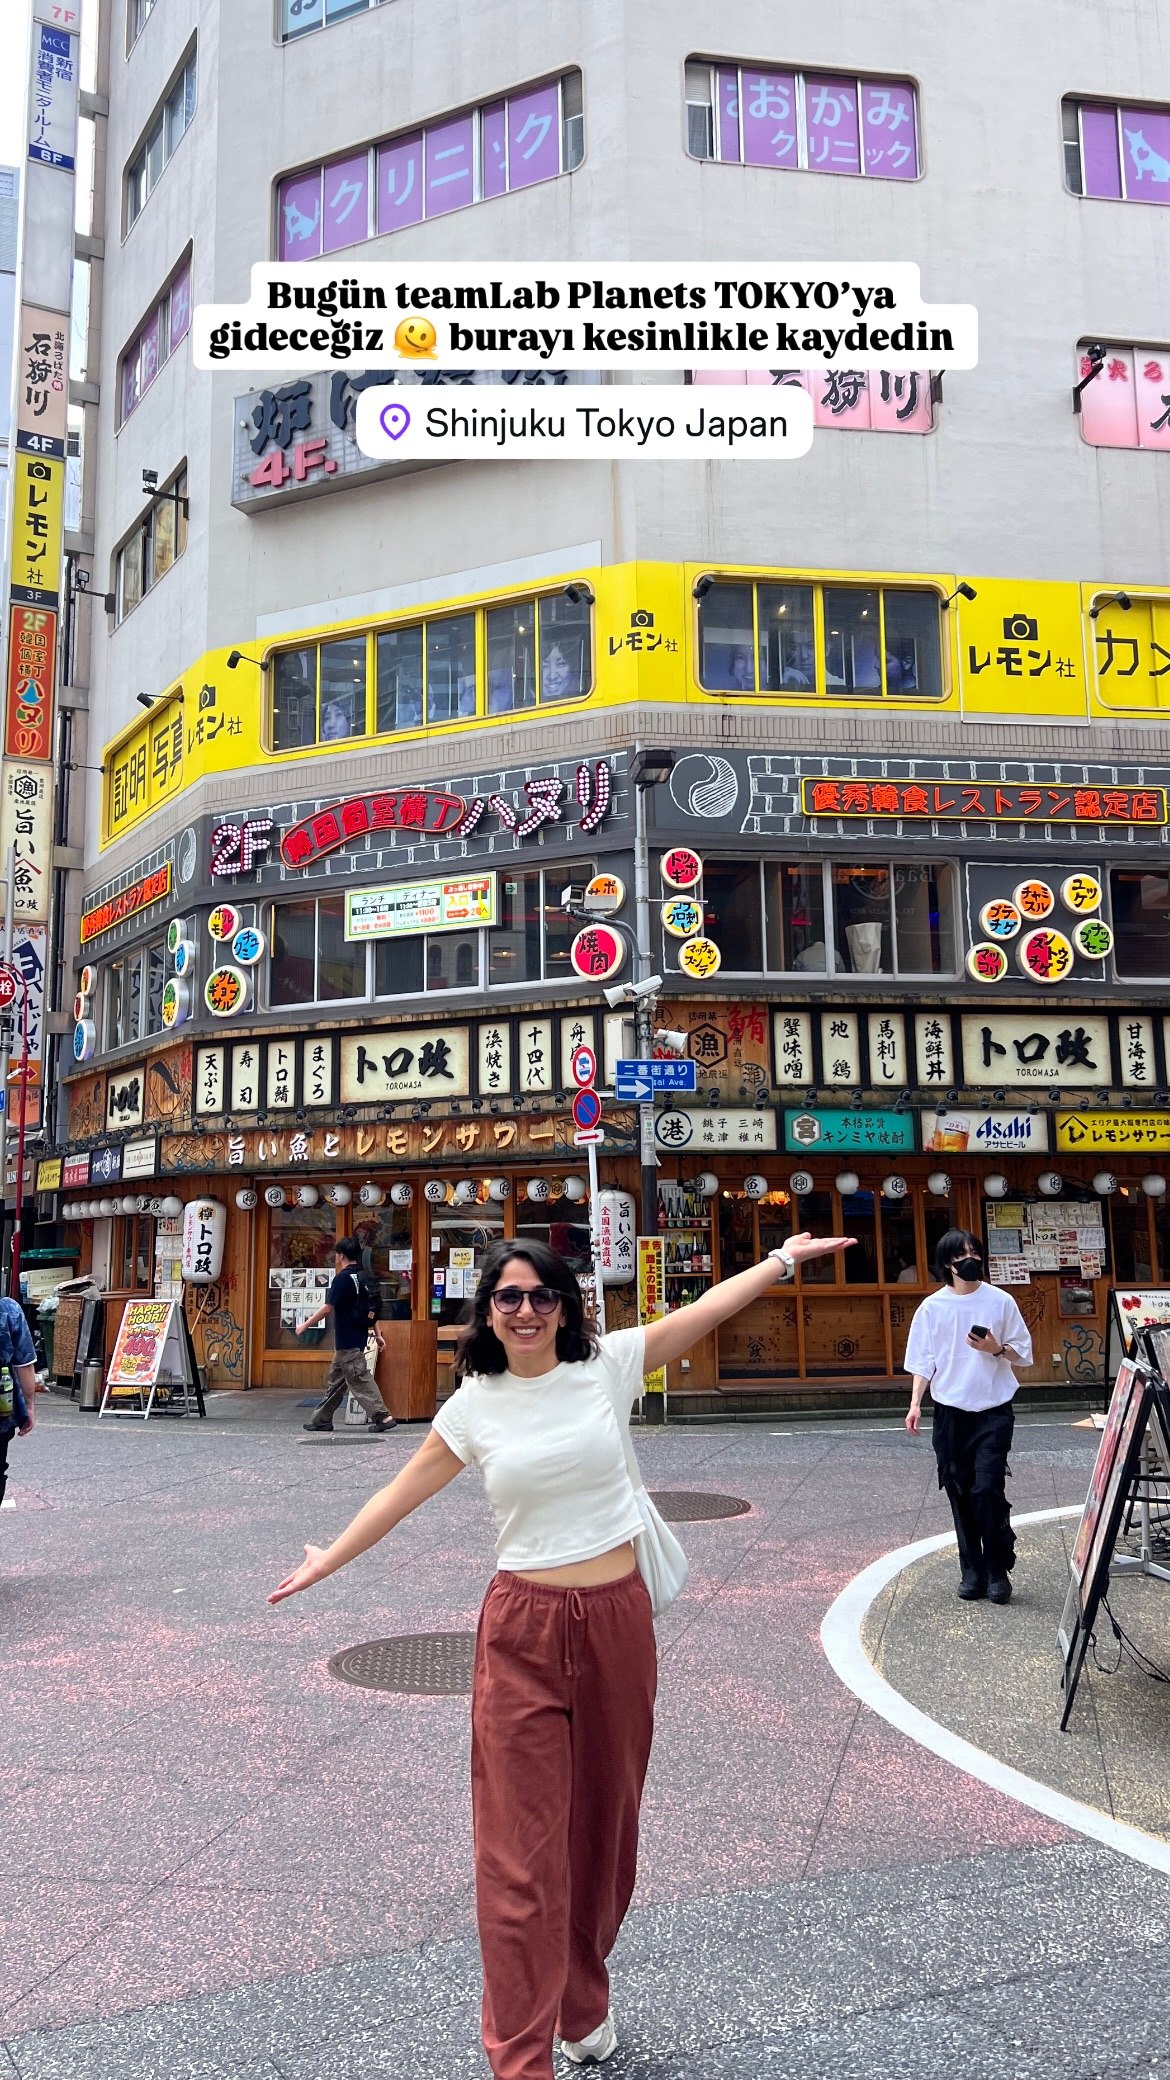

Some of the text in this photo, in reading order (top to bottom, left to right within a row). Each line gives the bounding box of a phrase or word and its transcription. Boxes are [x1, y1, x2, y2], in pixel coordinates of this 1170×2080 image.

[52, 6, 75, 22] 7F
[42, 35, 69, 51] MCC
[55, 56, 73, 82] 新宿
[40, 149, 63, 163] 6F
[771, 129, 912, 168] クリニック
[24, 332, 53, 417] 石狩川
[26, 435, 54, 452] 4F
[26, 590, 43, 601] 3F
[23, 611, 47, 632] 2F
[968, 645, 1076, 678] レモン社
[457, 761, 611, 837] ハヌリ
[811, 782, 1159, 820] 優秀韓食レストラン認定店
[284, 794, 461, 864] 韓国個室横丁
[210, 818, 274, 877] 2F
[362, 896, 385, 906] ランチ
[402, 889, 437, 900] ディナー
[1021, 886, 1050, 913] チャミスル
[210, 907, 235, 940] ホルモン
[578, 931, 609, 974] 焼肉
[485, 1029, 504, 1089] 浜焼き
[526, 1025, 546, 1087] 十四代
[694, 1030, 721, 1058] 漁
[783, 1017, 803, 1079] 蟹味噌
[829, 1019, 851, 1080] 地鶏
[876, 1018, 896, 1080] 馬刺し
[923, 1019, 947, 1082] 海鮮丼
[980, 1026, 1098, 1070] トロ政
[1126, 1021, 1147, 1082] 甘海老
[238, 1049, 254, 1105] 寿司
[311, 1044, 327, 1100] まぐろ
[356, 1037, 455, 1085] トロ政
[622, 1063, 689, 1078] 二番街通り
[1015, 1068, 1060, 1077] TOROMASA
[203, 1053, 219, 1108] 天ぷら
[385, 1080, 422, 1091] TOROMASA
[668, 1079, 687, 1087] Ave.
[661, 1117, 685, 1142] 港
[796, 1118, 817, 1139] 宮
[822, 1130, 906, 1146] キンミヤ焼酎
[975, 1115, 1032, 1139] Asahi
[1091, 1129, 1170, 1143] レモンサワー
[227, 1122, 554, 1166] 旨い魚とレモンサワー
[983, 1139, 1027, 1149] アサヒビール
[614, 1202, 634, 1258] 旨い魚
[194, 1223, 213, 1276] トロ政
[129, 1303, 166, 1316] HAPPY
[283, 1291, 323, 1304] 個室 有り
